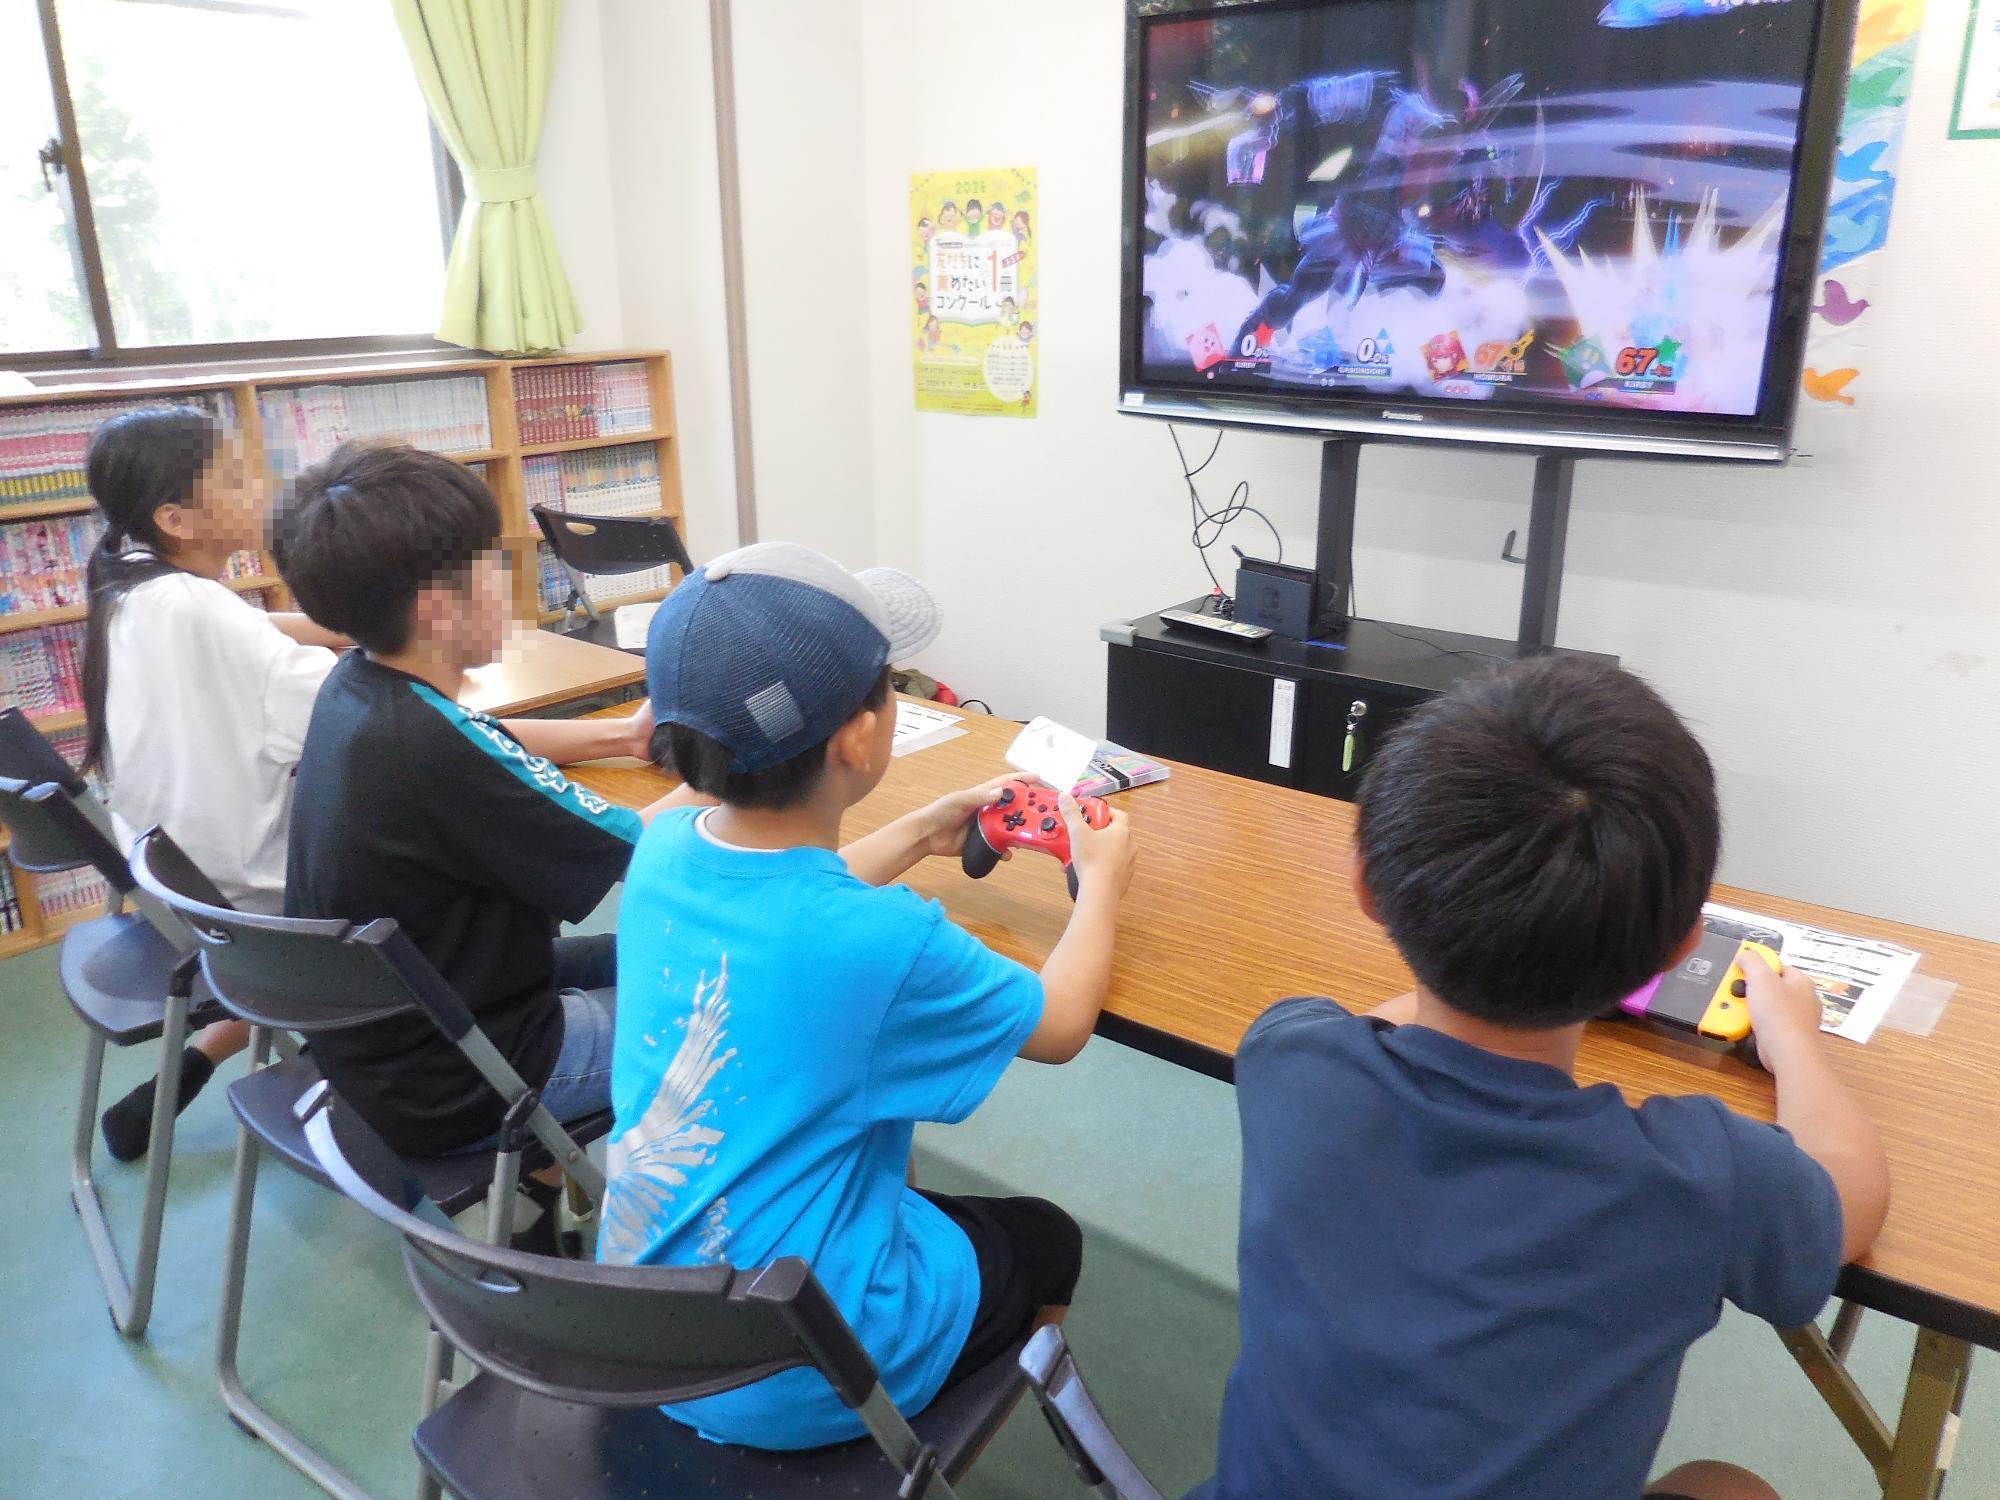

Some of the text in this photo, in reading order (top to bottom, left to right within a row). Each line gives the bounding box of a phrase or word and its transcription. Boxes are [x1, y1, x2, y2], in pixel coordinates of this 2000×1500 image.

[936, 290, 992, 311] コンクール
